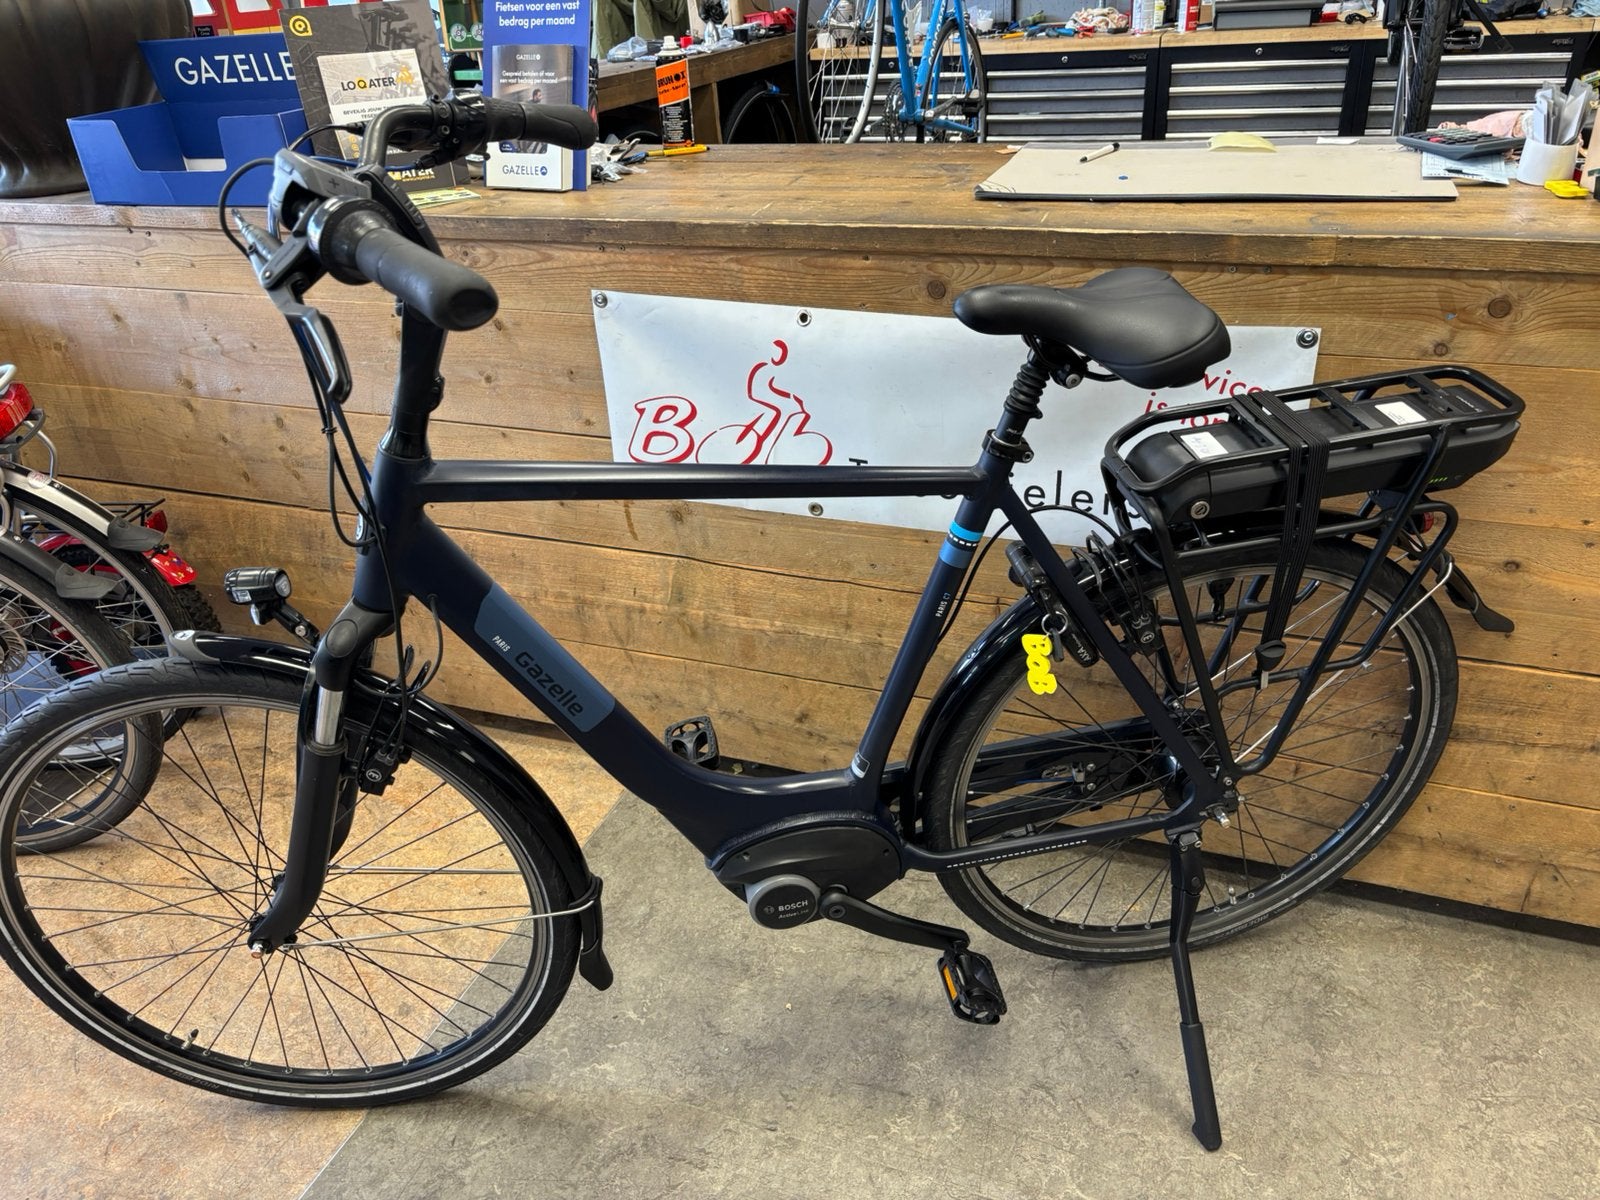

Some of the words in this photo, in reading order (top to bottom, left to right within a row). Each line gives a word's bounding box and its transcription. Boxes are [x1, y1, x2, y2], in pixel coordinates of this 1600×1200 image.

[495, 1, 524, 12] Fietsen
[525, 3, 544, 11] voor
[546, 2, 561, 11] een
[562, 0, 580, 10] vast
[499, 15, 529, 29] bedrag
[530, 18, 544, 29] per
[546, 14, 576, 25] maand
[174, 51, 297, 86] GAZELLE
[340, 77, 397, 92] LOQATER
[502, 165, 540, 175] GAZELLE
[935, 600, 949, 618] PARIS
[492, 635, 511, 652] PARIS
[515, 651, 584, 717] Gazelle
[778, 899, 809, 912] BOSCH
